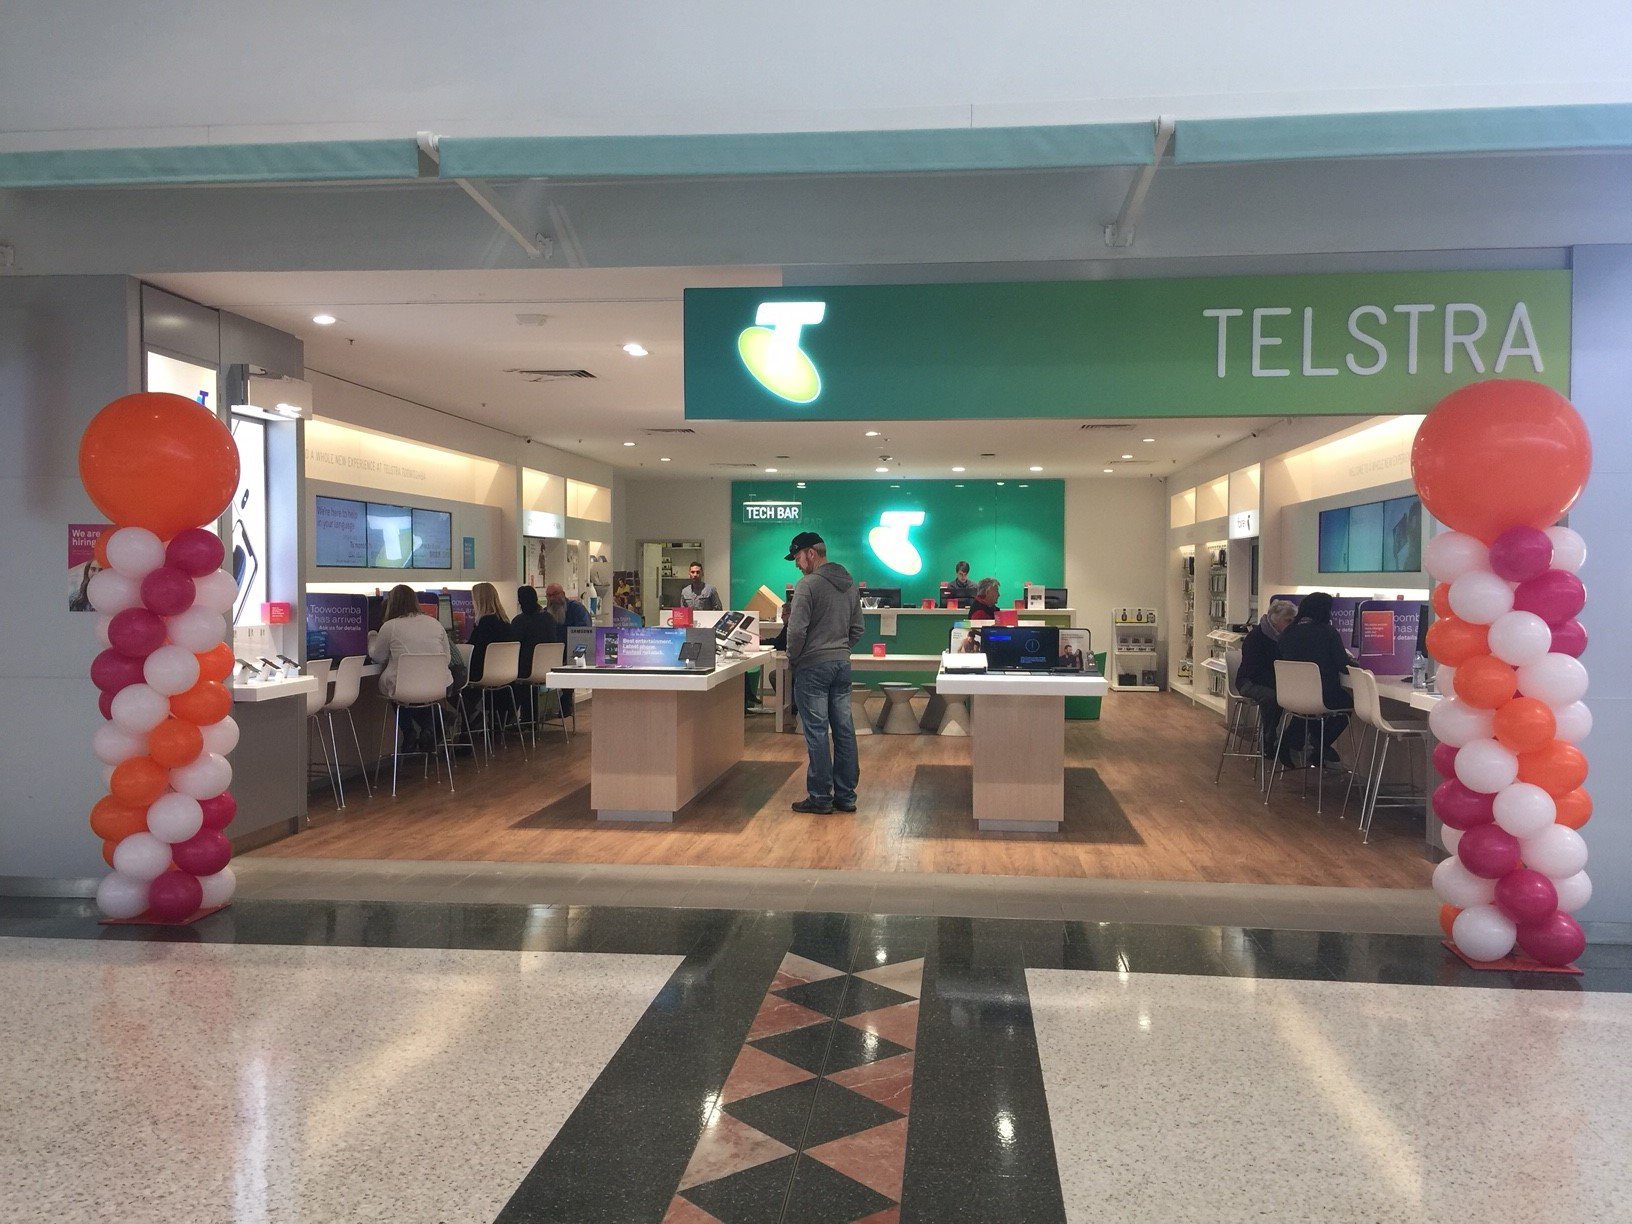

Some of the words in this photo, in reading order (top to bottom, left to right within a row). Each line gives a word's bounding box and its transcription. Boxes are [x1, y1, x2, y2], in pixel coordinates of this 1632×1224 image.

[1203, 301, 1544, 378] TELSTRA
[316, 451, 334, 464] WHOLE
[335, 454, 347, 466] NEW
[348, 456, 376, 472] EXPERIENCE
[746, 507, 775, 519] TECH
[777, 507, 799, 519] BAR
[72, 529, 86, 538] We
[72, 538, 97, 548] hiring
[310, 604, 362, 614] Toowoomba
[314, 615, 331, 623] has
[331, 615, 362, 624] arrived
